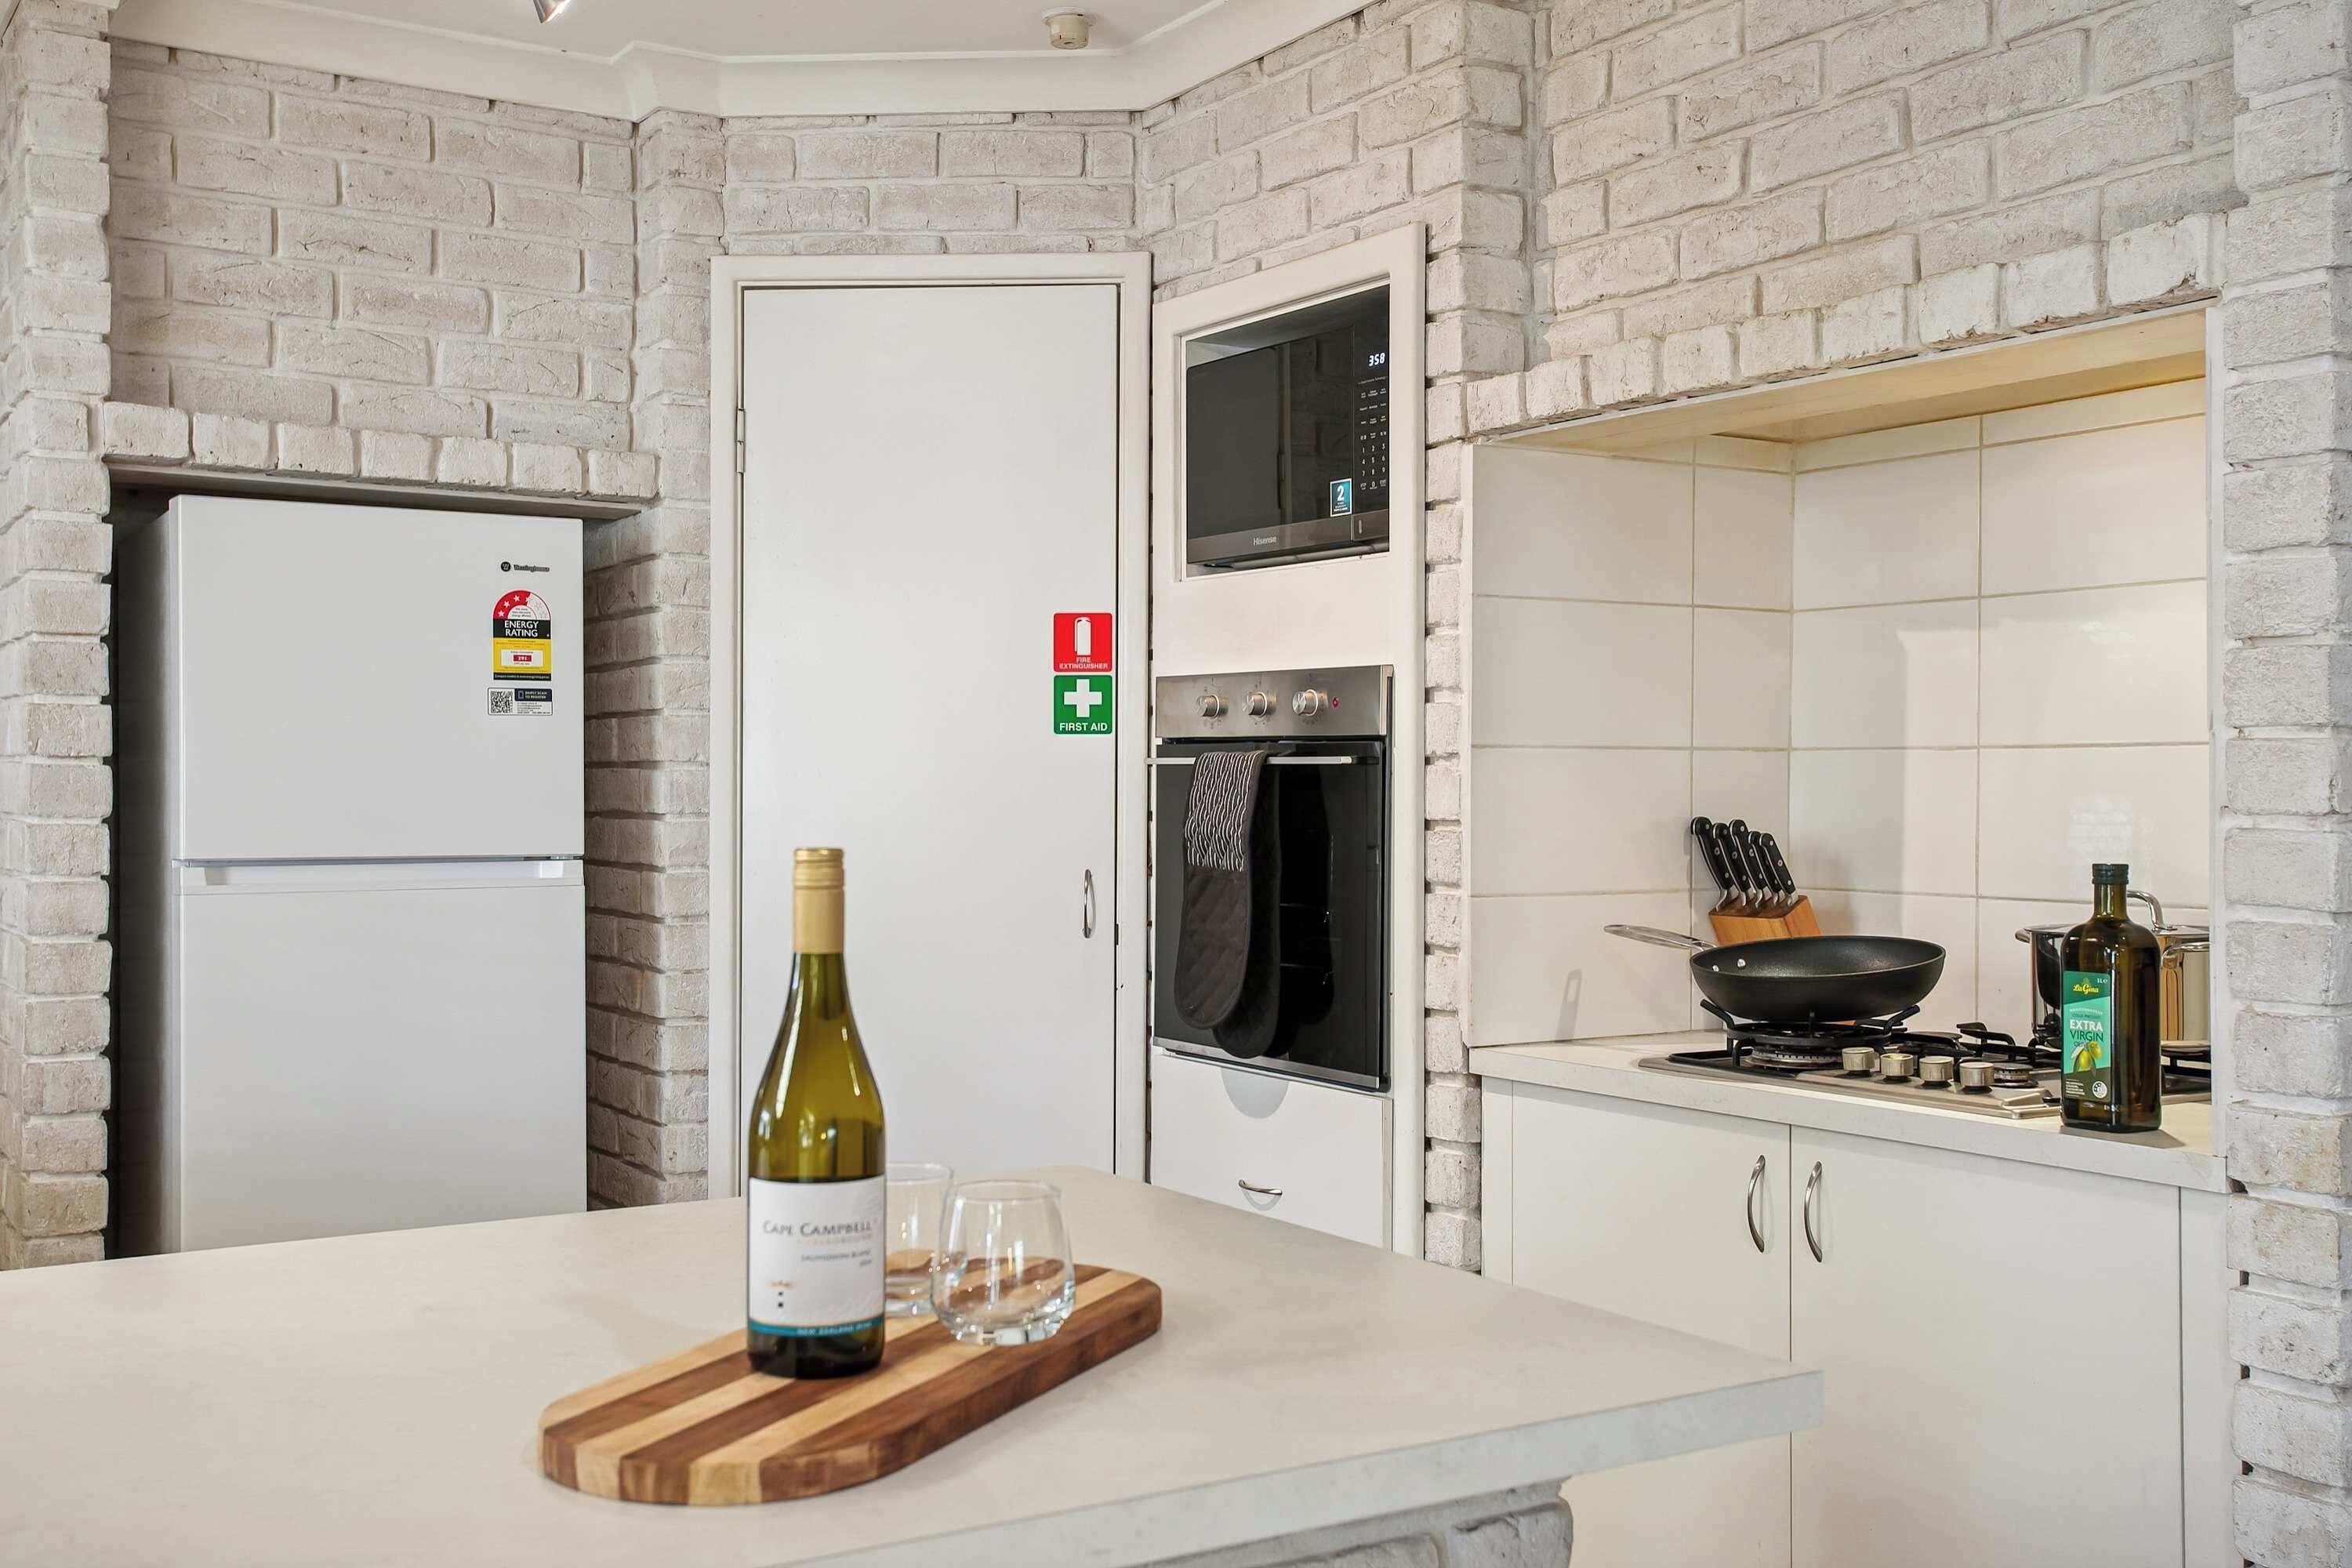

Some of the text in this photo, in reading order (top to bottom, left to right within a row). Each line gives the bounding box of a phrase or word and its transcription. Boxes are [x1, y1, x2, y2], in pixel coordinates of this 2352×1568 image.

[1337, 485, 1345, 502] 2
[1253, 535, 1277, 546] Hisense
[504, 620, 539, 629] ENERGY
[505, 629, 539, 637] RATING
[1059, 722, 1108, 731] FIRST AID
[2069, 1019, 2103, 1032] EXTRA
[2070, 1029, 2103, 1042] VIRGIN
[763, 1220, 871, 1236] CAPE CAMPBELL
[797, 1327, 816, 1336] NEW
